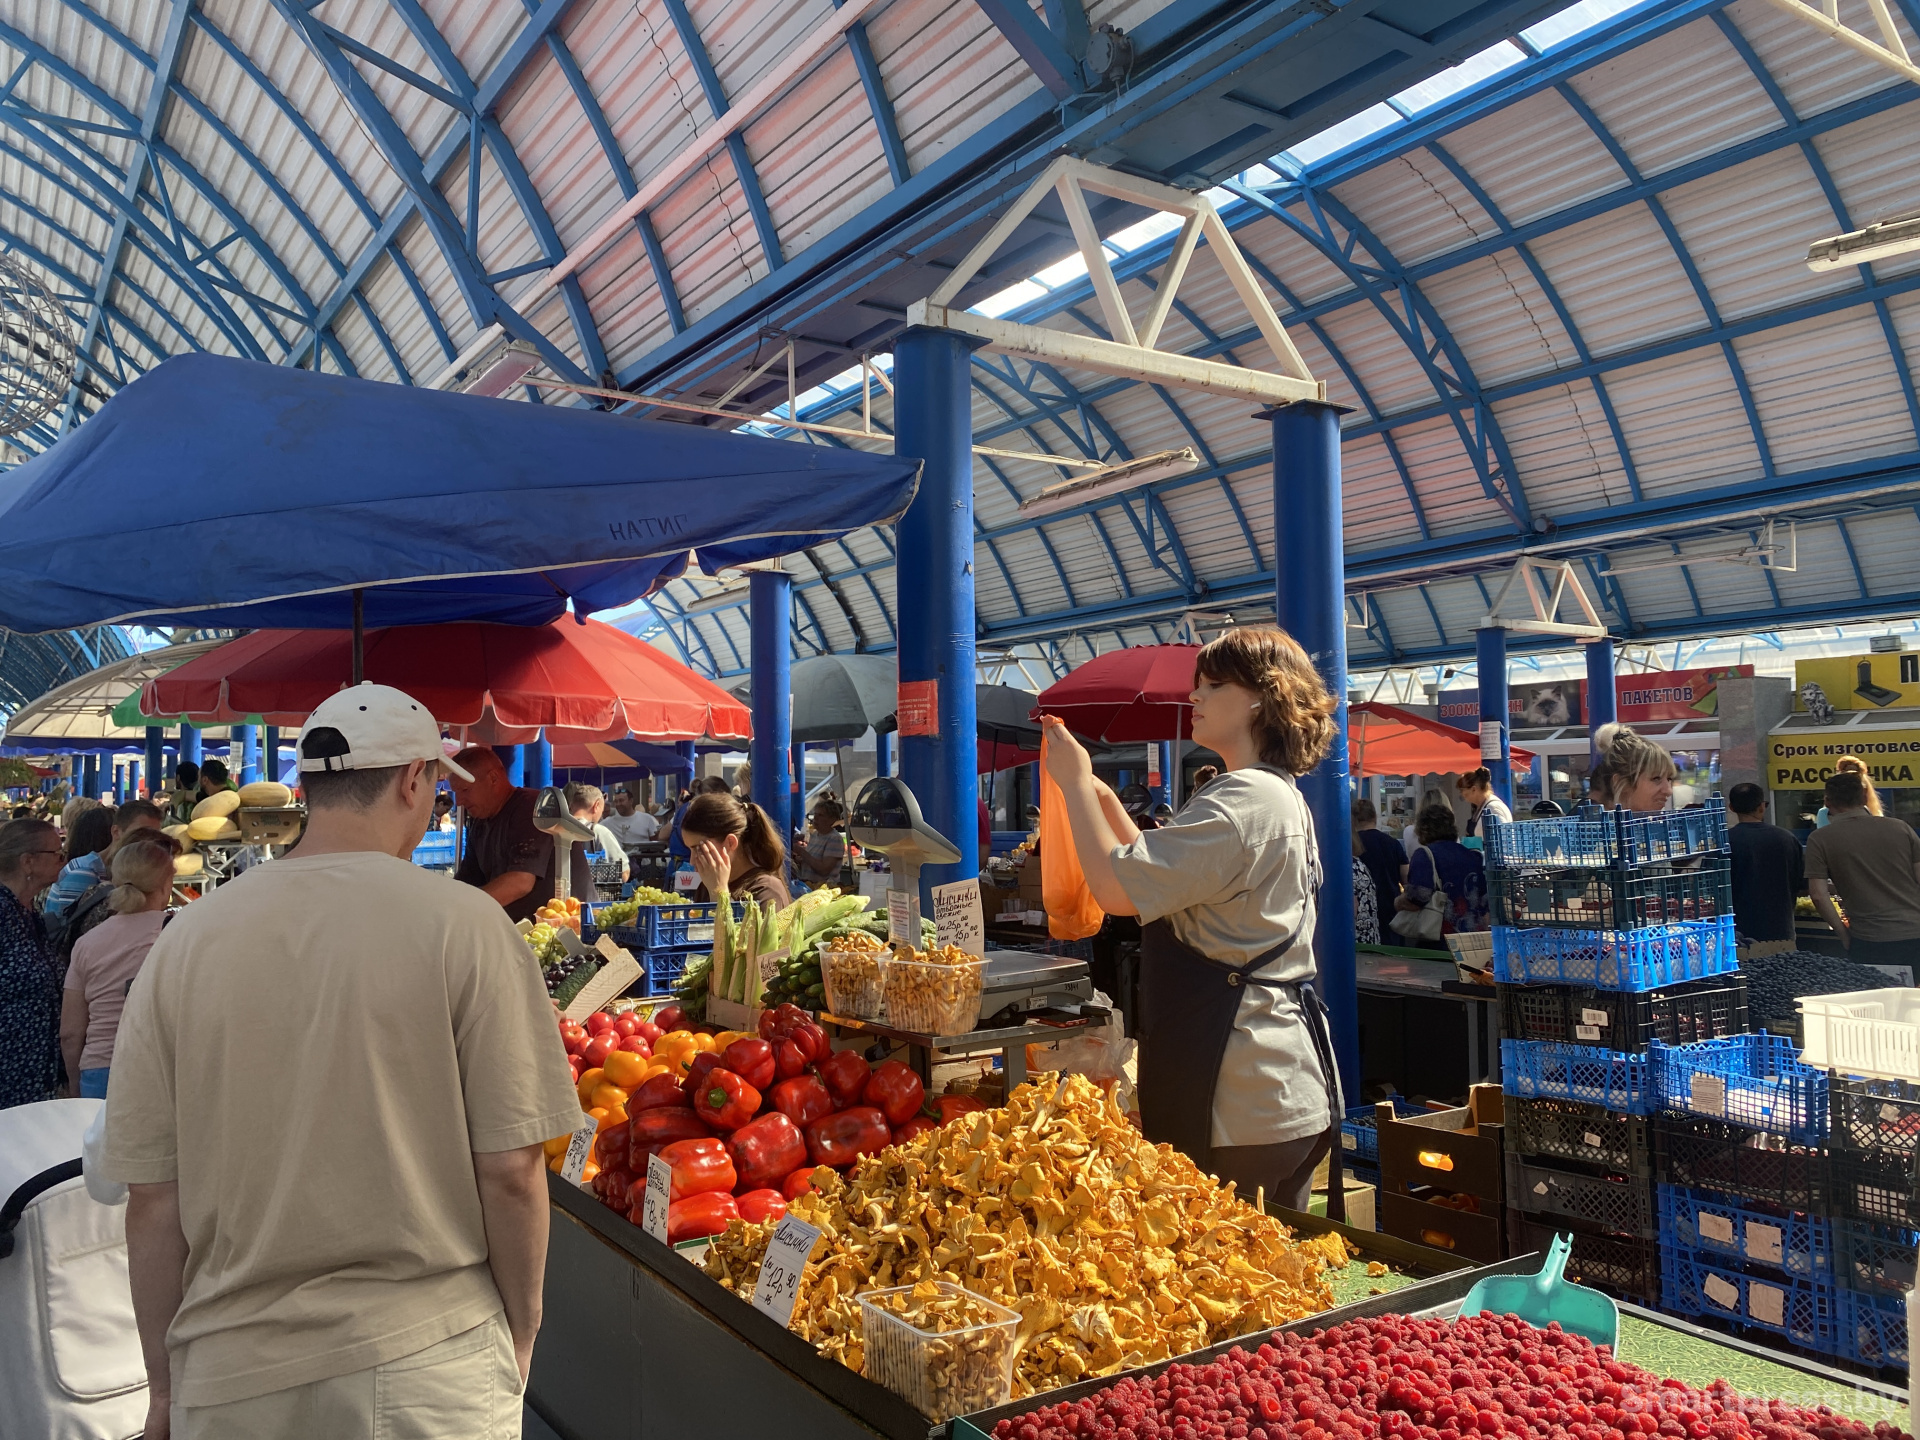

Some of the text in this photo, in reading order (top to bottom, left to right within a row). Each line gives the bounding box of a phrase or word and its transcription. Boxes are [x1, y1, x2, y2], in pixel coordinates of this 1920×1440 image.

[608, 513, 688, 541] НАТИГ
[1622, 687, 1693, 705] ПАКЕТОВ
[1773, 743, 1819, 758] Срок
[1777, 765, 1914, 784] РАССЧКА
[933, 887, 977, 908] Лисички
[774, 1222, 809, 1254] Лисички
